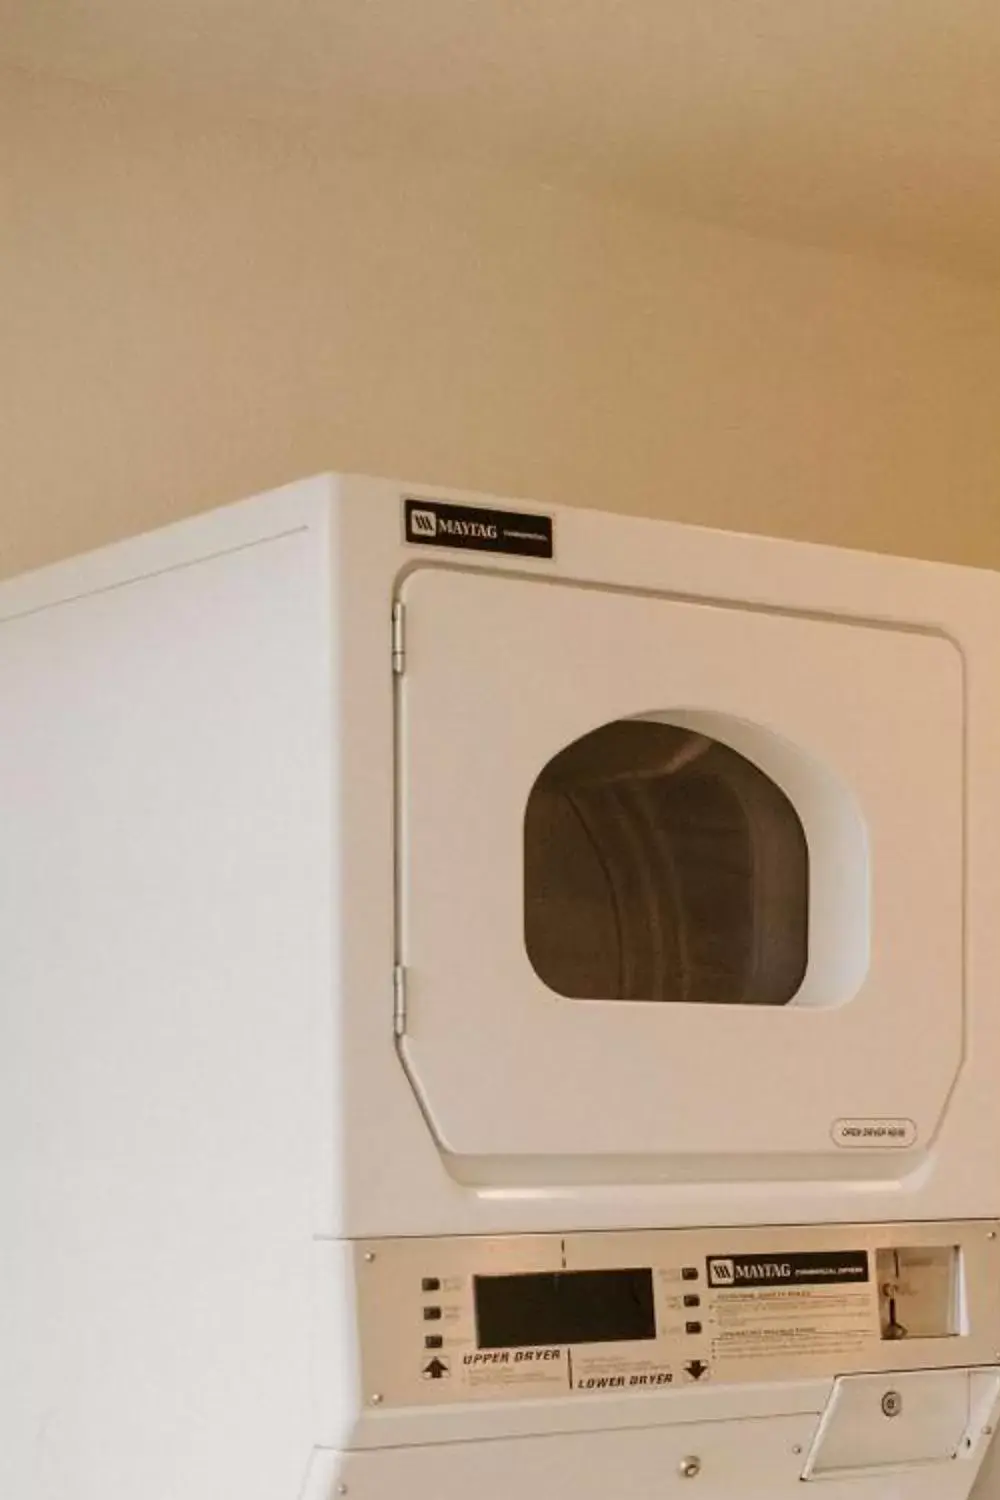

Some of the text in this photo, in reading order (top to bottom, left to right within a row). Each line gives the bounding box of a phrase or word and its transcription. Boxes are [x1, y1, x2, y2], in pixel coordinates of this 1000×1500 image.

[439, 519, 498, 539] MAYTAG
[735, 1263, 792, 1279] MAYTAG
[462, 1349, 561, 1366] UPPER DRYER
[577, 1375, 626, 1390] LOWER
[628, 1373, 674, 1385] DRYER
